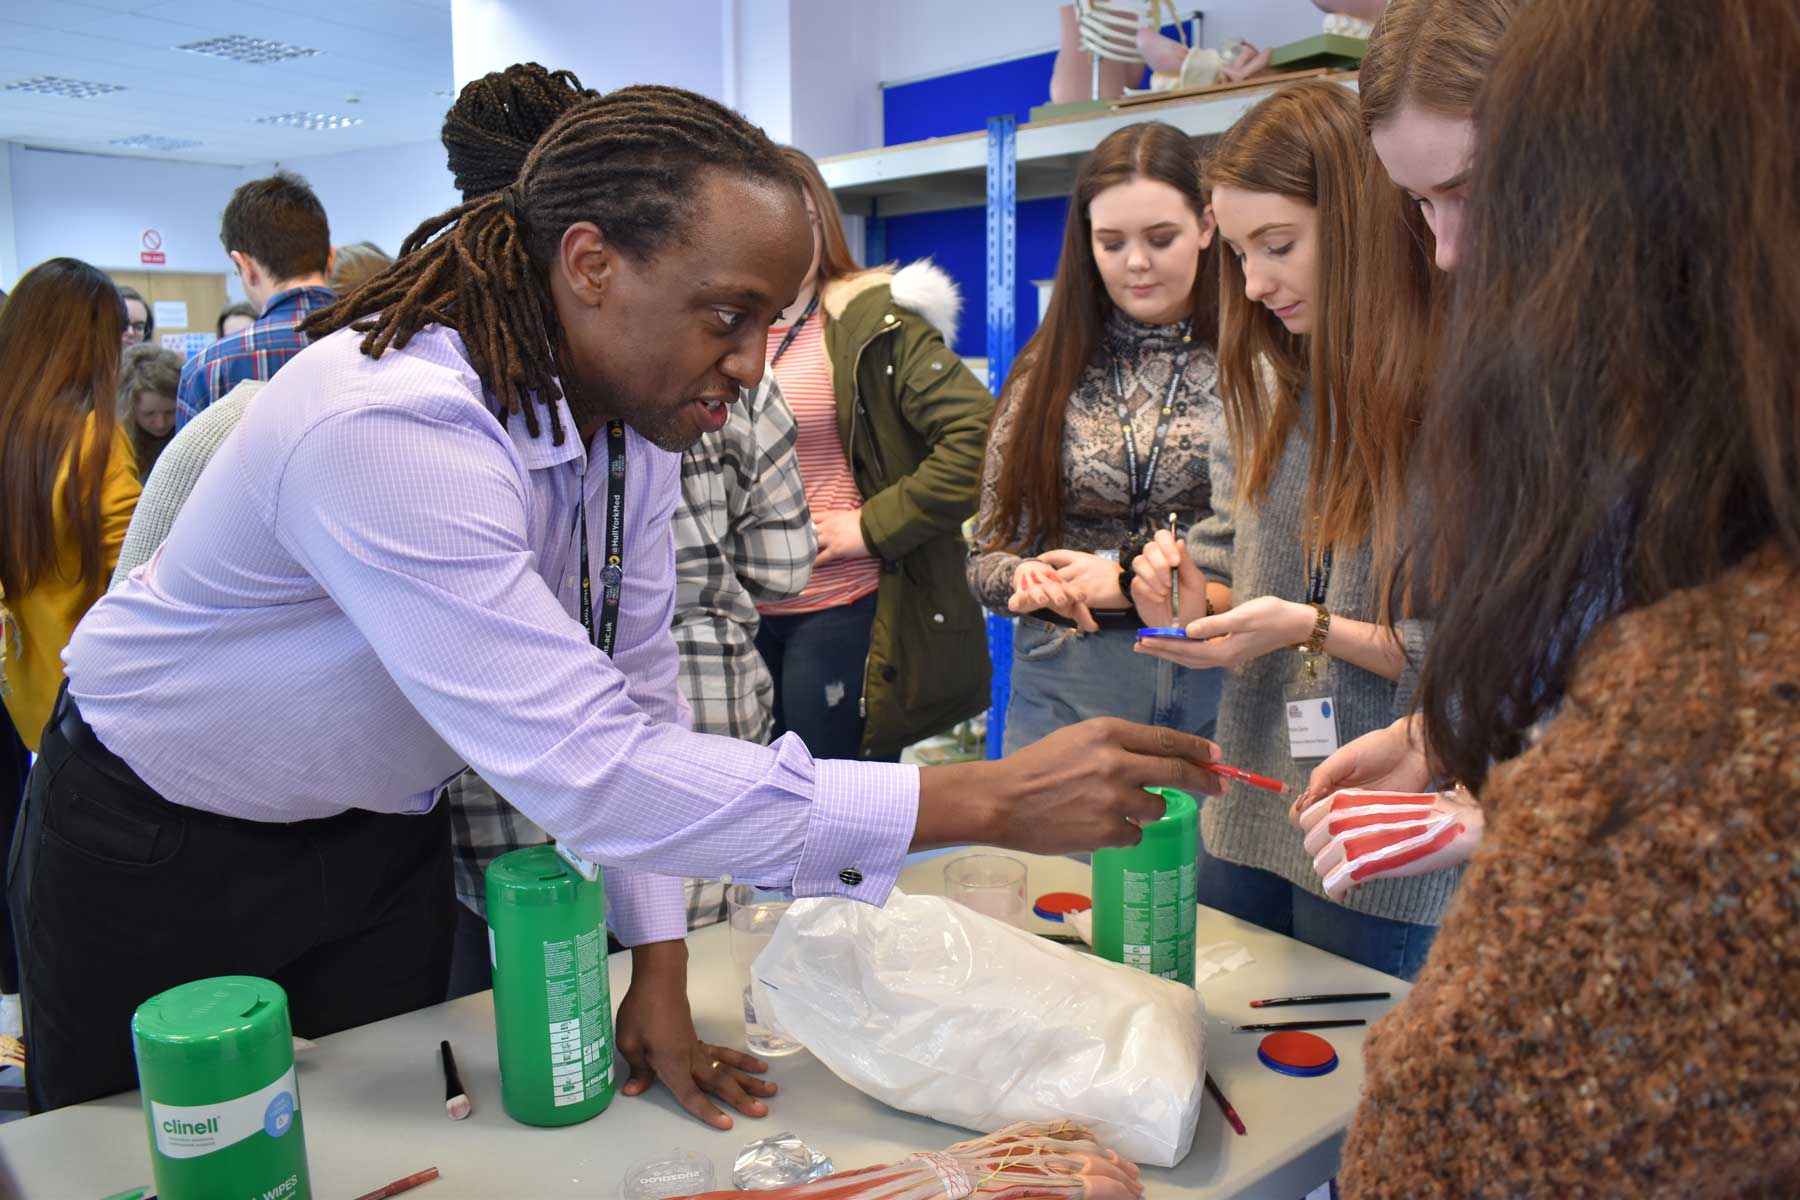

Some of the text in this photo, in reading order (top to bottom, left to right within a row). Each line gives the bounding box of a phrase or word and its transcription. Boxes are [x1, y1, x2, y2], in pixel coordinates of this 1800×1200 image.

[612, 494, 621, 555] @HullYorkMed
[163, 1118, 218, 1135] clinell
[263, 1174, 298, 1200] WIPES
